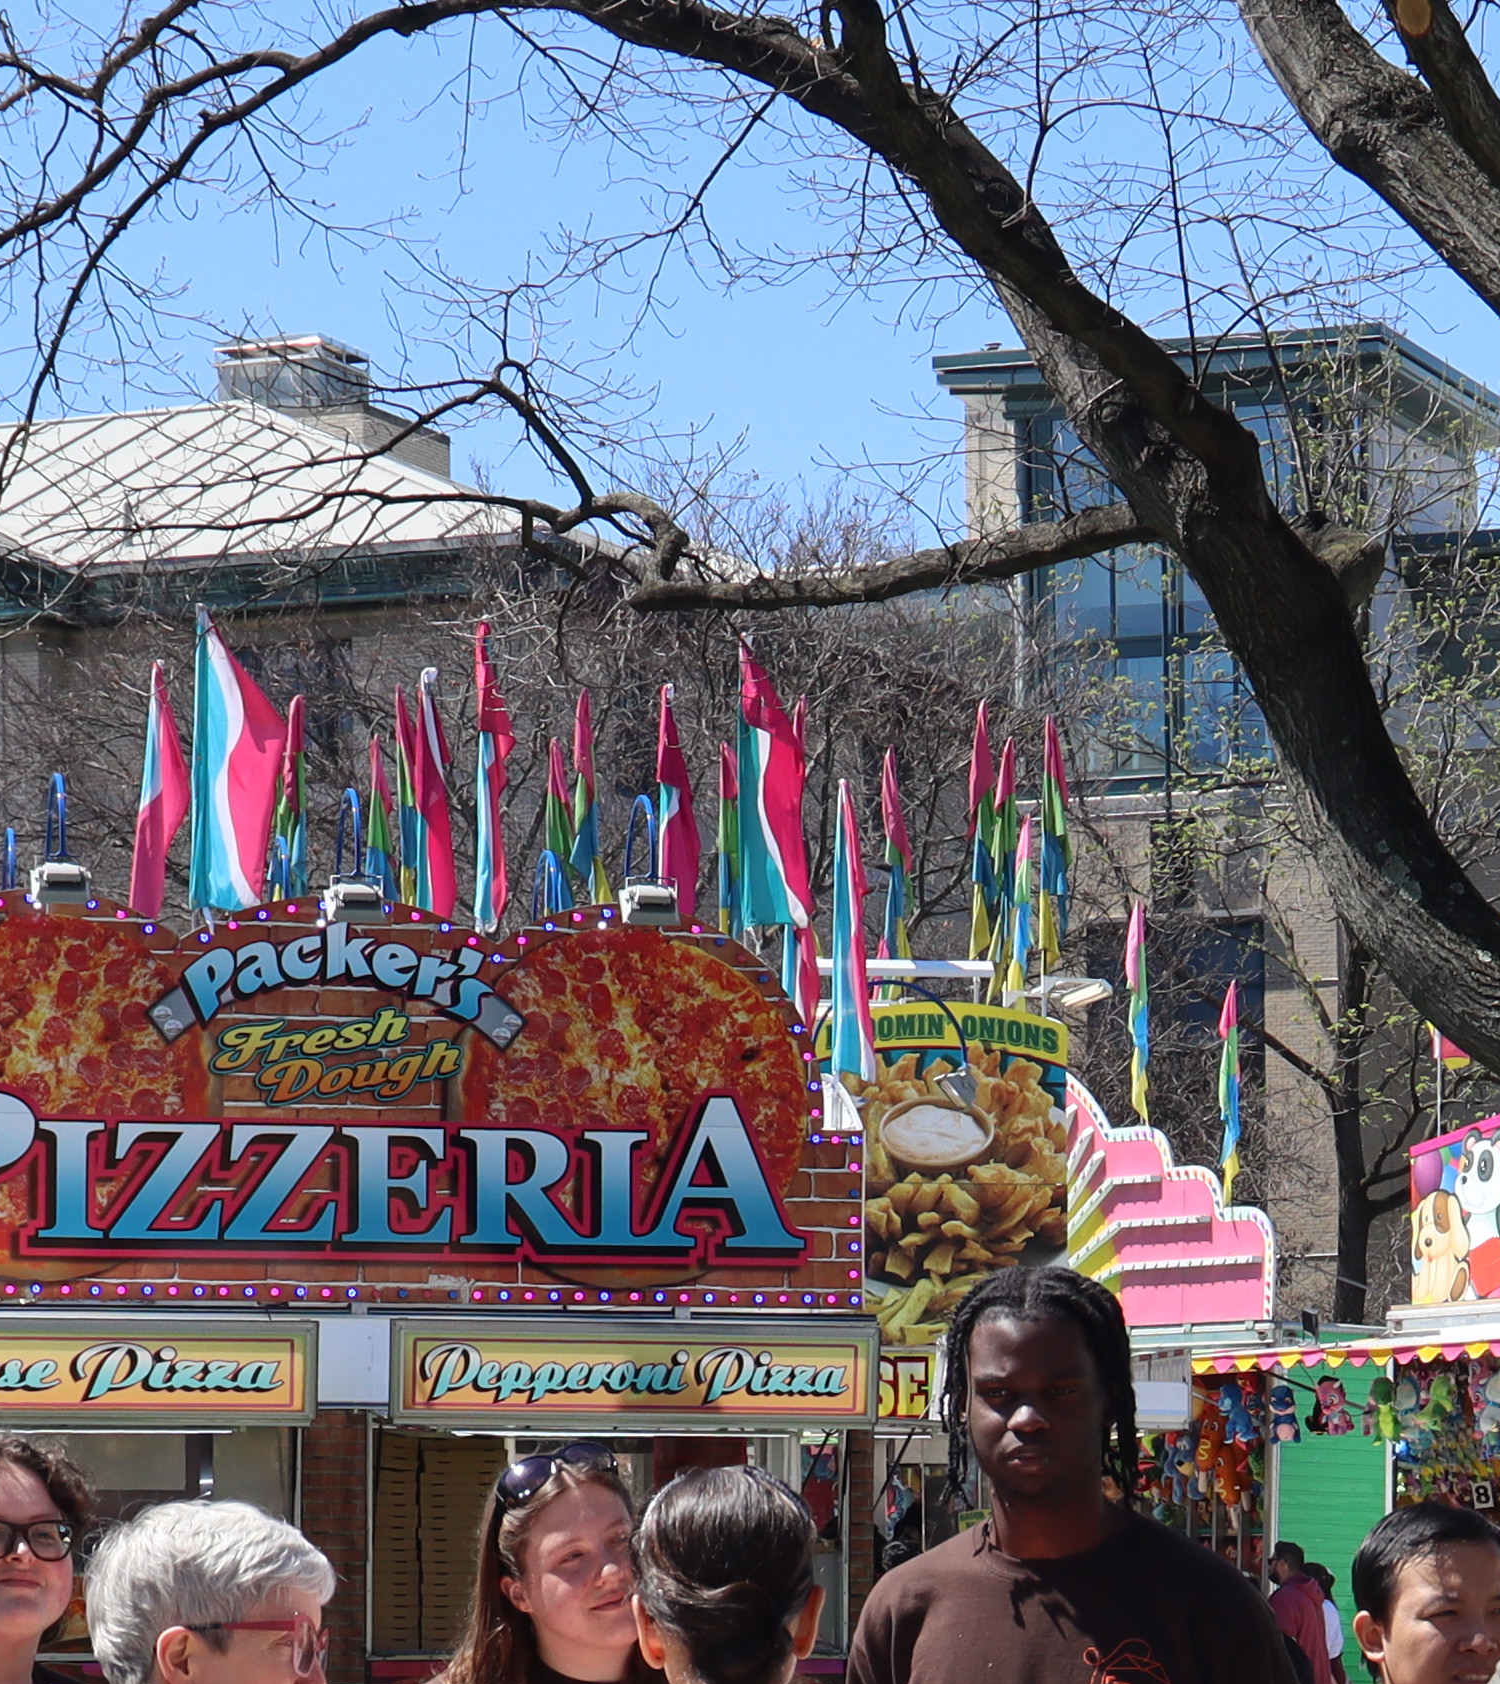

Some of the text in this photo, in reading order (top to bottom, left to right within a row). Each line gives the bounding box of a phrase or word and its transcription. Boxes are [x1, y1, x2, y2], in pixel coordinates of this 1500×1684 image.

[183, 922, 495, 1022] Packer's
[214, 1010, 407, 1072] Fresh
[961, 1014, 1059, 1052] ONIONS
[258, 1042, 462, 1103] Dough
[70, 1342, 285, 1401] Pizza
[421, 1342, 849, 1404] Pepperoni Pizza
[1474, 1484, 1491, 1505] 8
